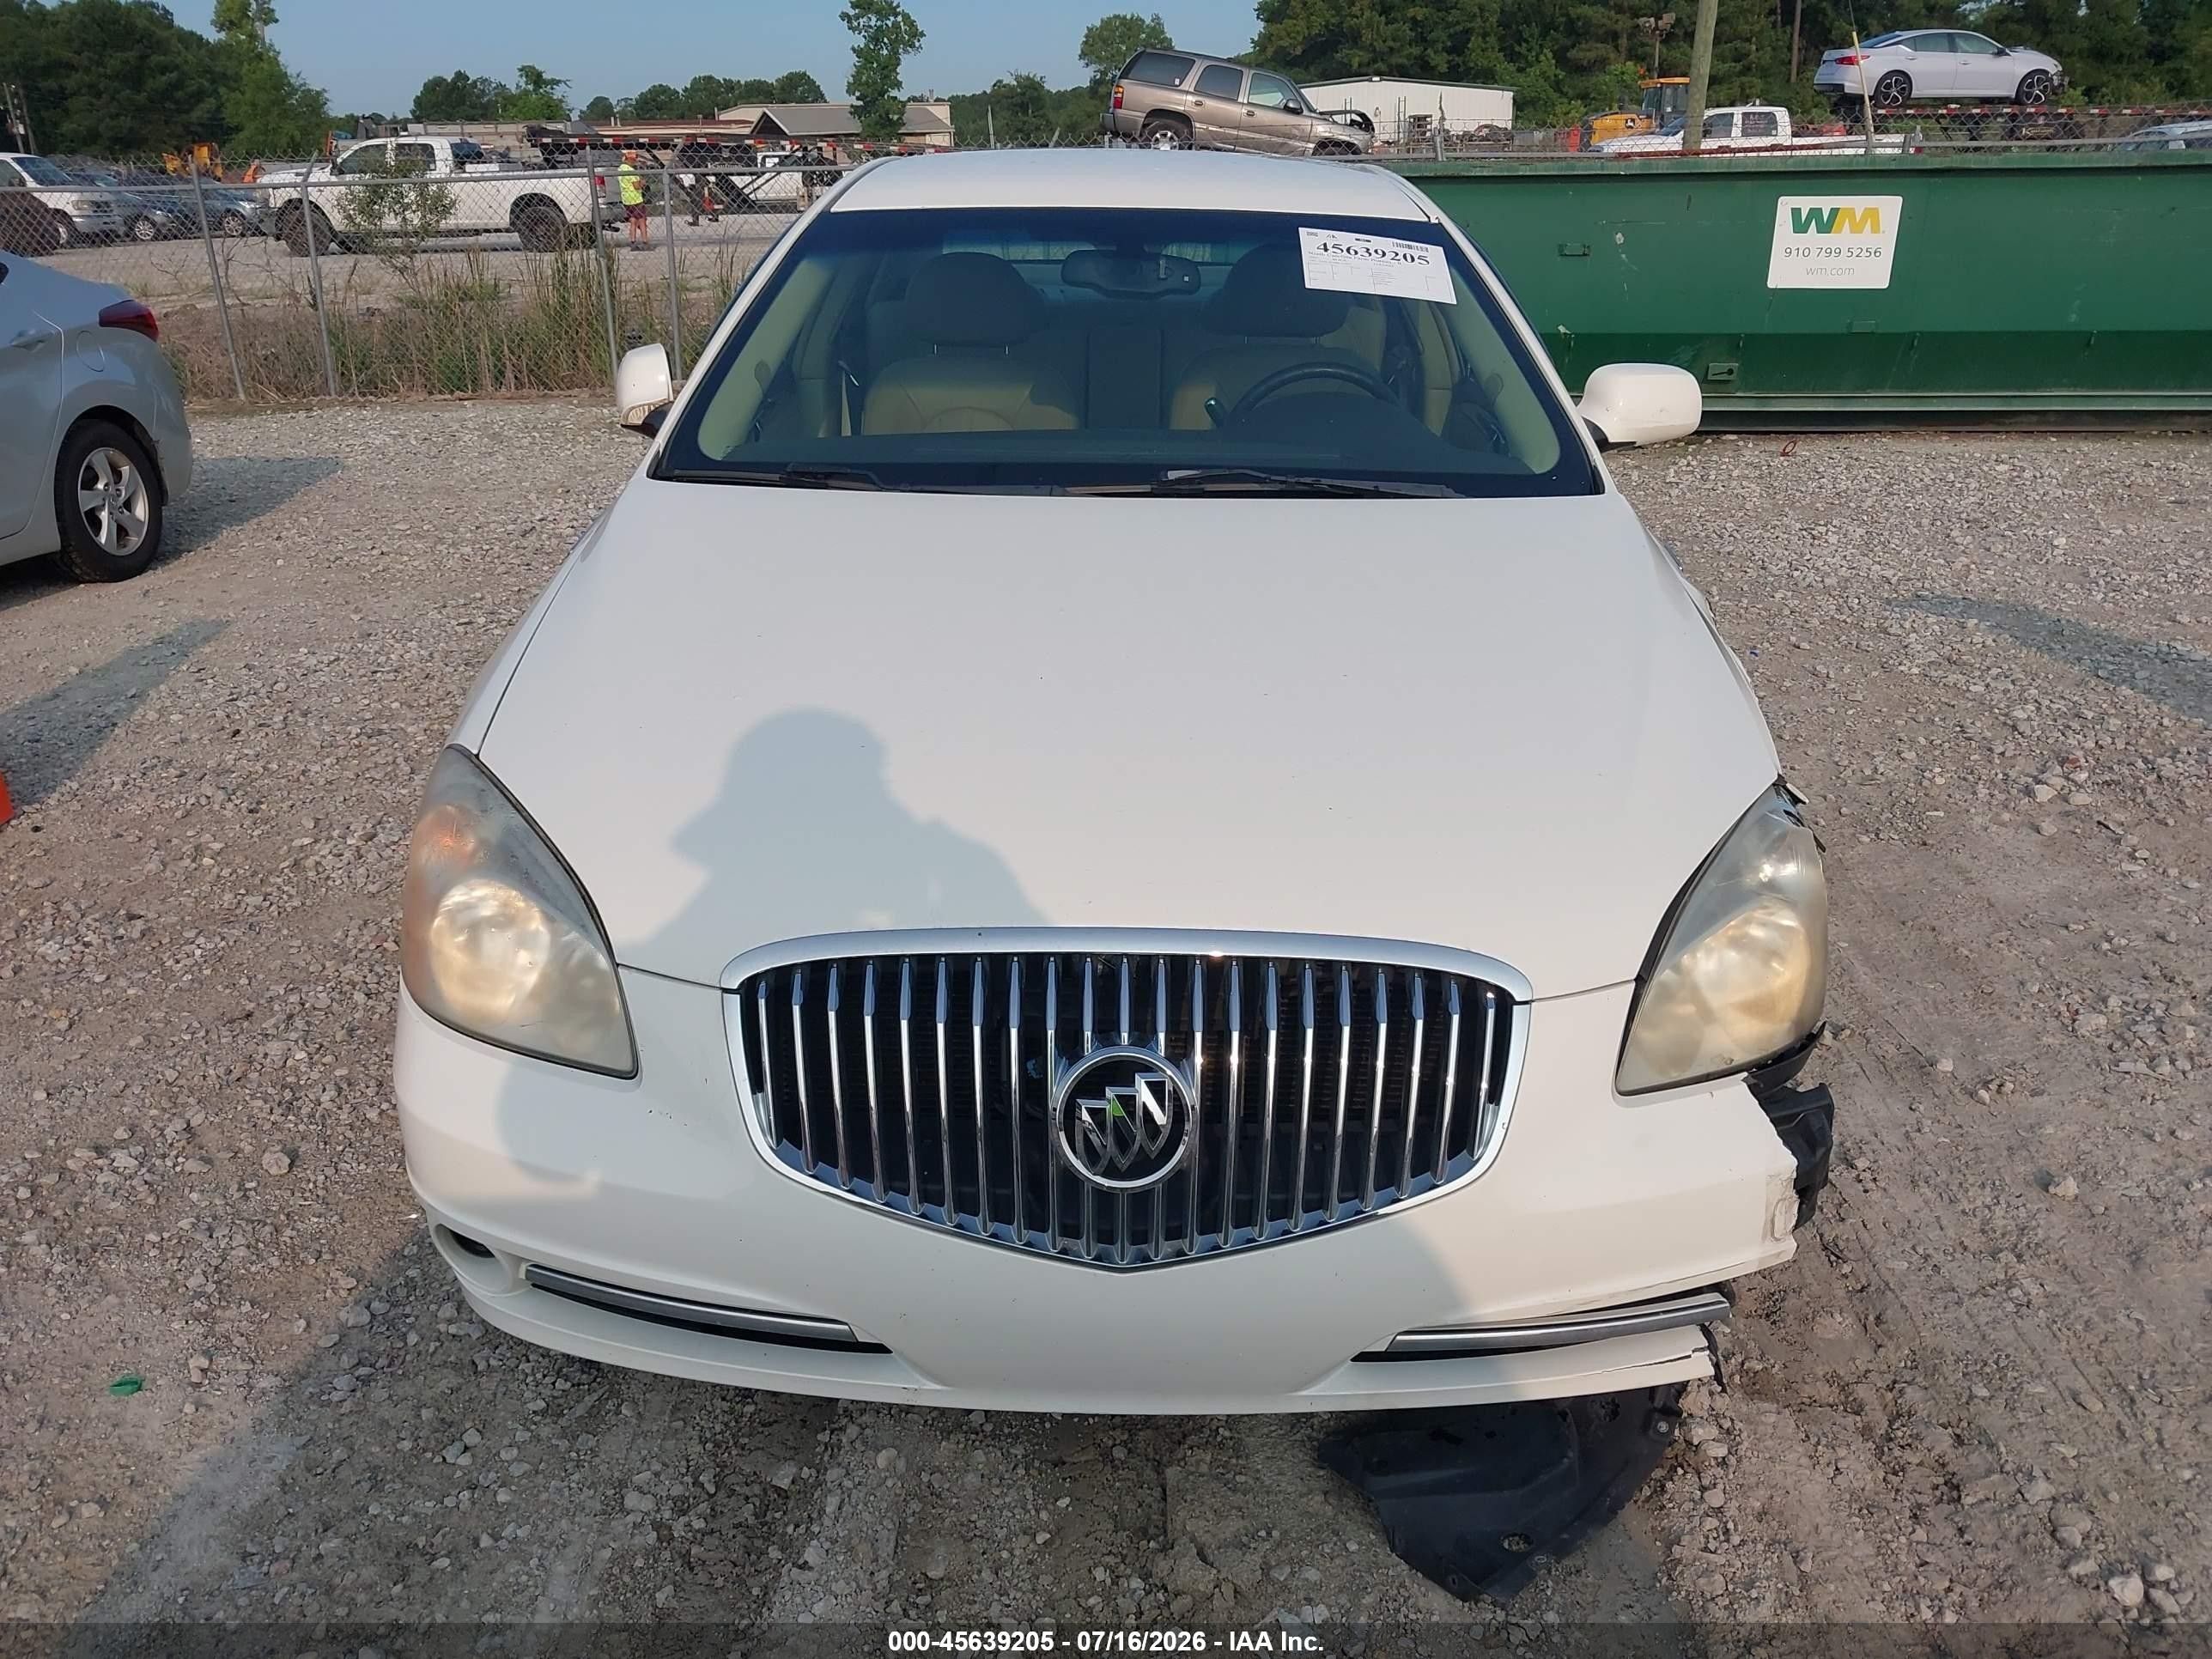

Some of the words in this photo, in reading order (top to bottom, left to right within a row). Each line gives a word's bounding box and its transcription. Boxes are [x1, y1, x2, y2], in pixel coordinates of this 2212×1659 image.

[1790, 207, 1881, 234] WM
[1316, 242, 1430, 266] 45639205
[1784, 246, 1811, 258] 910
[1815, 246, 1842, 258] 799
[1846, 246, 1882, 258] 5256
[1806, 267, 1855, 276] wm.com
